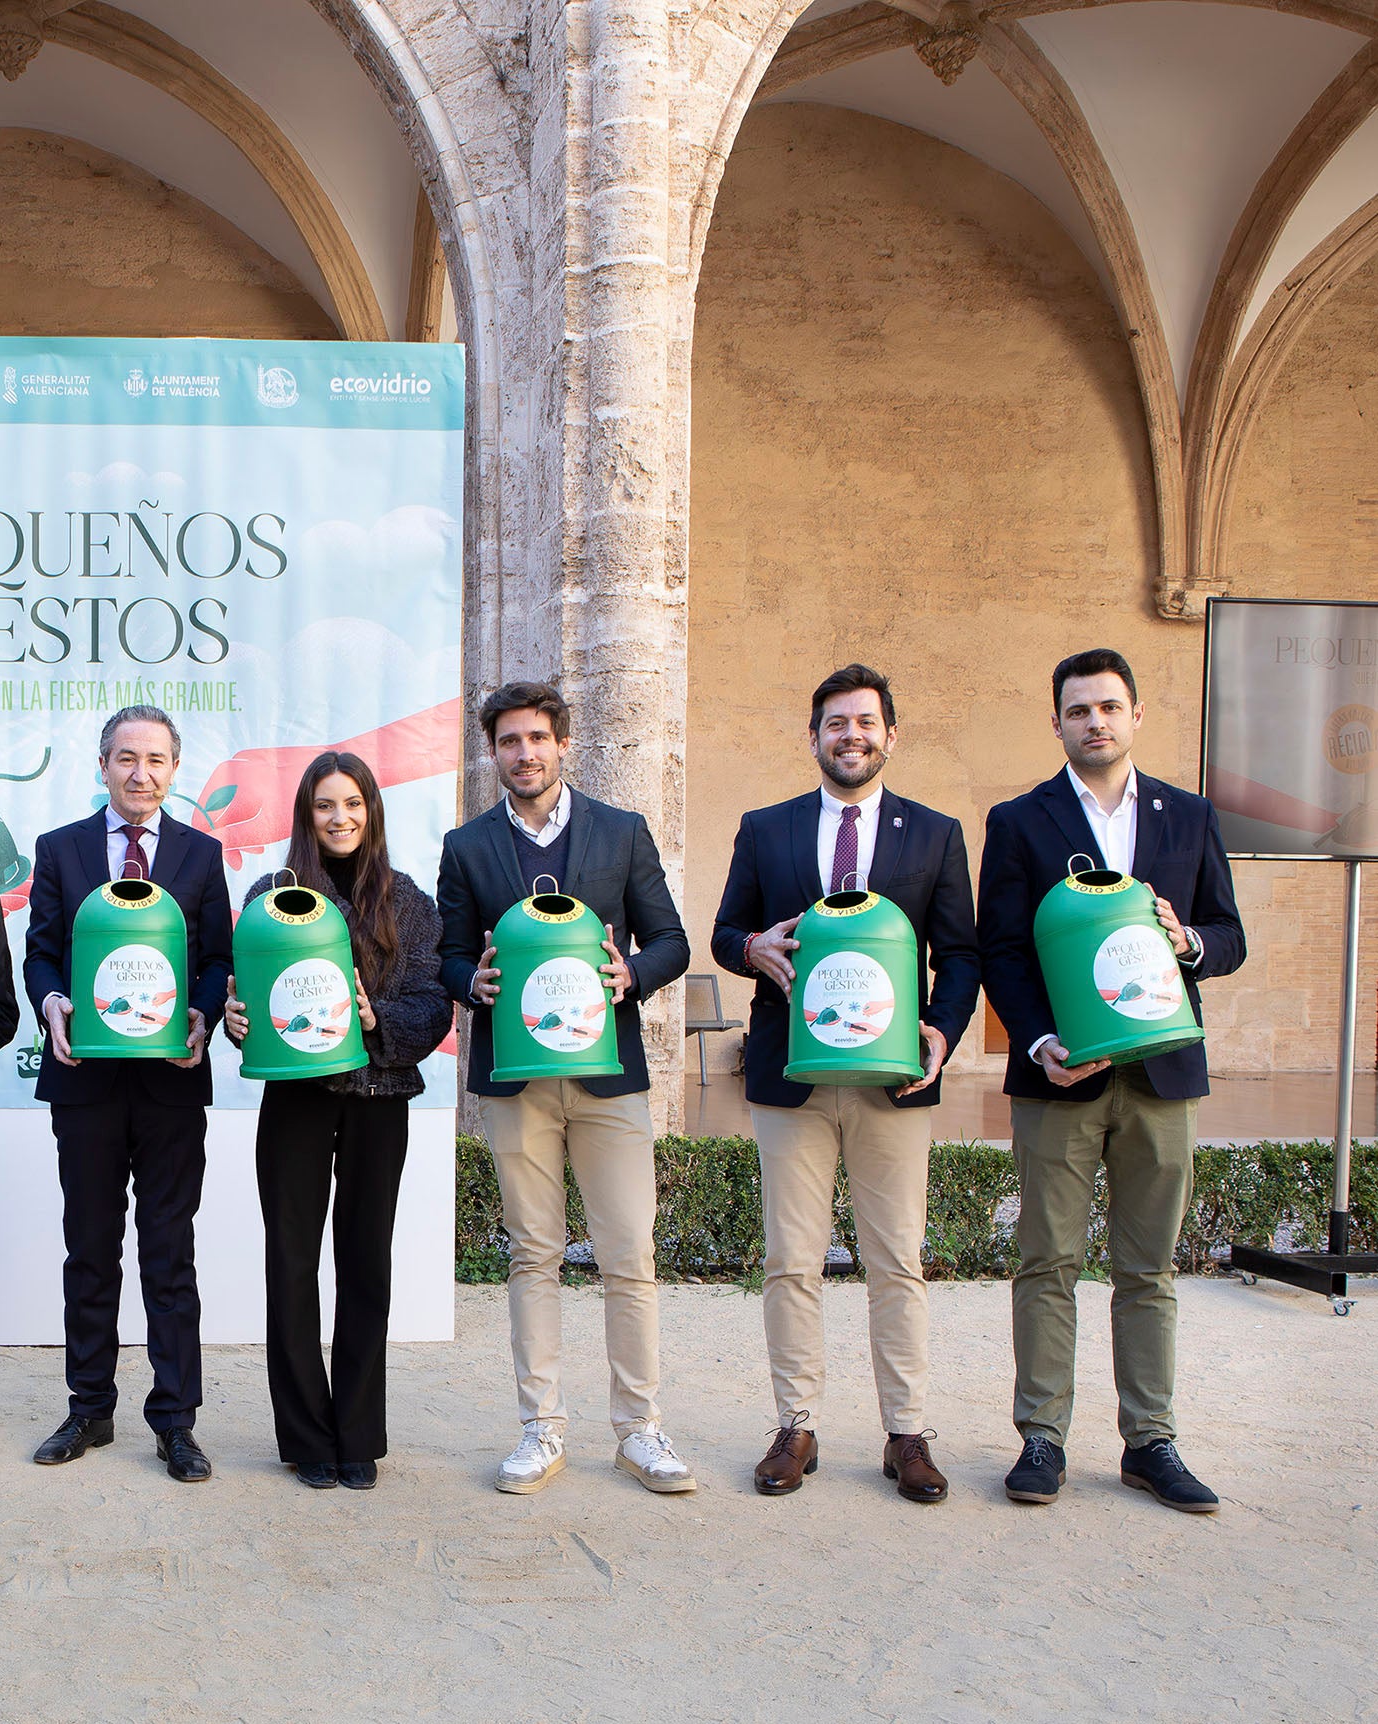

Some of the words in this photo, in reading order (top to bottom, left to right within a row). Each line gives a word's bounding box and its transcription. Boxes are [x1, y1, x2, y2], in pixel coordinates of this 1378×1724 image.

[21, 375, 91, 385] GENERALITAT
[152, 376, 221, 386] AJUNTAMENT
[330, 372, 432, 395] ecovidrio
[22, 385, 90, 396] VALENCIANA
[152, 387, 166, 396] DE
[1275, 635, 1378, 670] PEQUE
[21, 680, 43, 711] LA
[50, 681, 109, 711] FIESTA
[115, 676, 156, 710] MÁS
[163, 681, 243, 712] GRANDE.
[1073, 883, 1104, 894] SOLO
[104, 892, 126, 908] SOLO
[131, 892, 161, 908] VIDRIO
[270, 908, 295, 924] SOLO
[299, 902, 326, 924] VIDRIO
[526, 907, 551, 922] SOLO
[837, 900, 873, 916] VIDRIO
[116, 971, 157, 982] GESTOS
[293, 984, 333, 999] GESTOS
[544, 985, 587, 996] GESTOS
[824, 979, 870, 991] GESTOS
[834, 1036, 858, 1044] ecovidrio
[15, 1051, 42, 1070] Re
